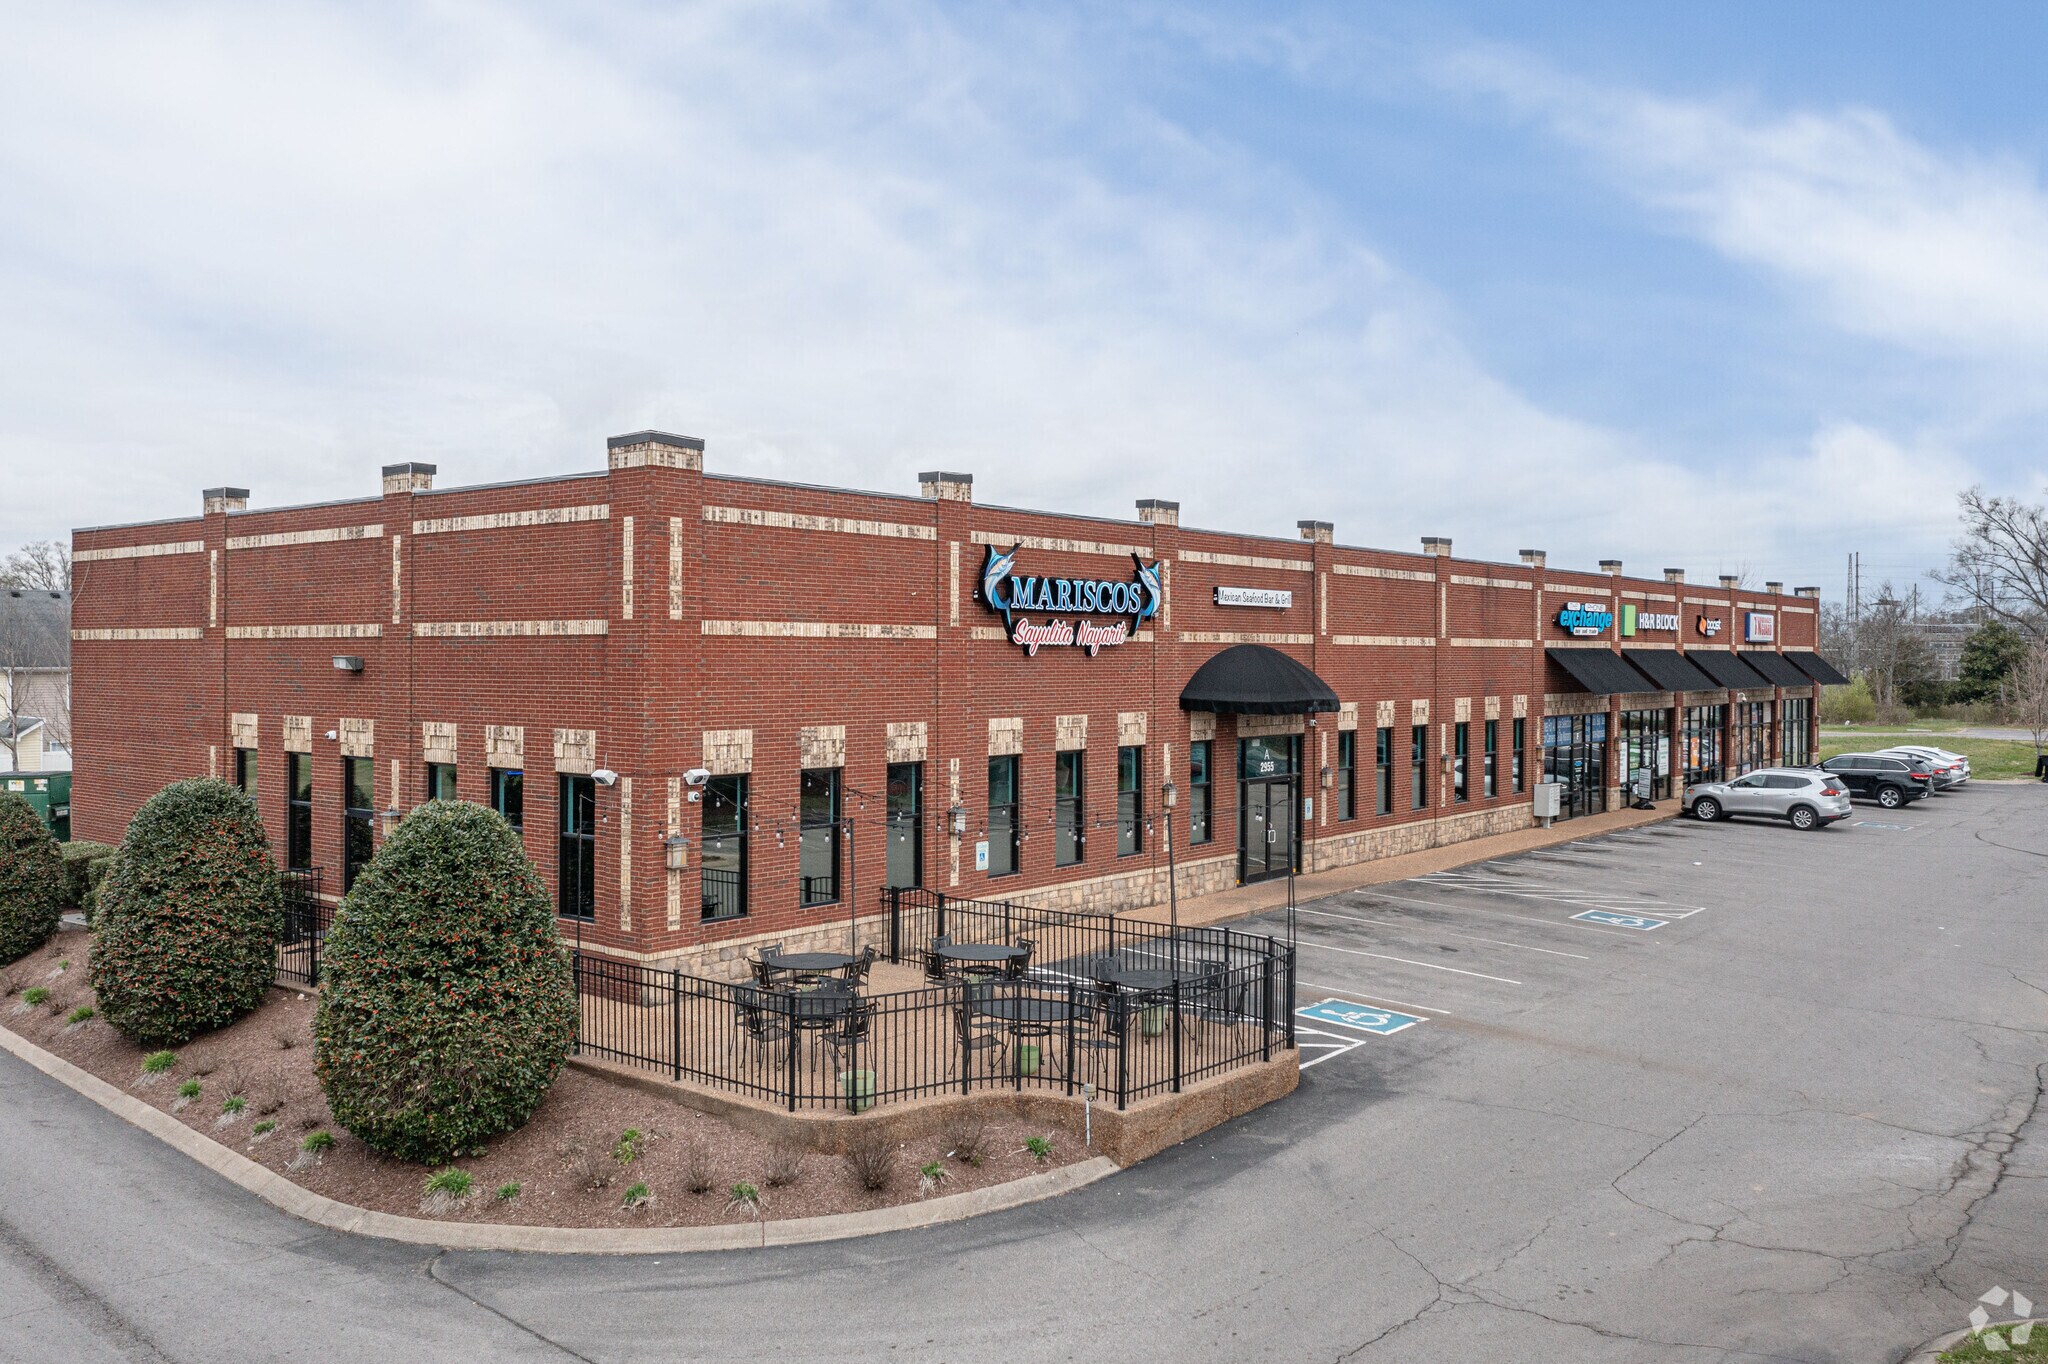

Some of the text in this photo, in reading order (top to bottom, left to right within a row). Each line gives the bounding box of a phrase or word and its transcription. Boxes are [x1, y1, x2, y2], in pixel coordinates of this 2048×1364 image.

[1011, 577, 1141, 612] MARISCOS
[1218, 590, 1241, 602] Mexican
[1242, 591, 1264, 604] Seafood
[1264, 593, 1274, 604] Bar
[1275, 593, 1280, 605] &
[1560, 604, 1612, 632] exchange
[1639, 612, 1679, 631] H&R BLOCK
[1706, 618, 1721, 630] boost
[1013, 618, 1126, 656] Sayulita Nayarit
[1264, 749, 1270, 760] A
[1260, 761, 1274, 772] 2955
